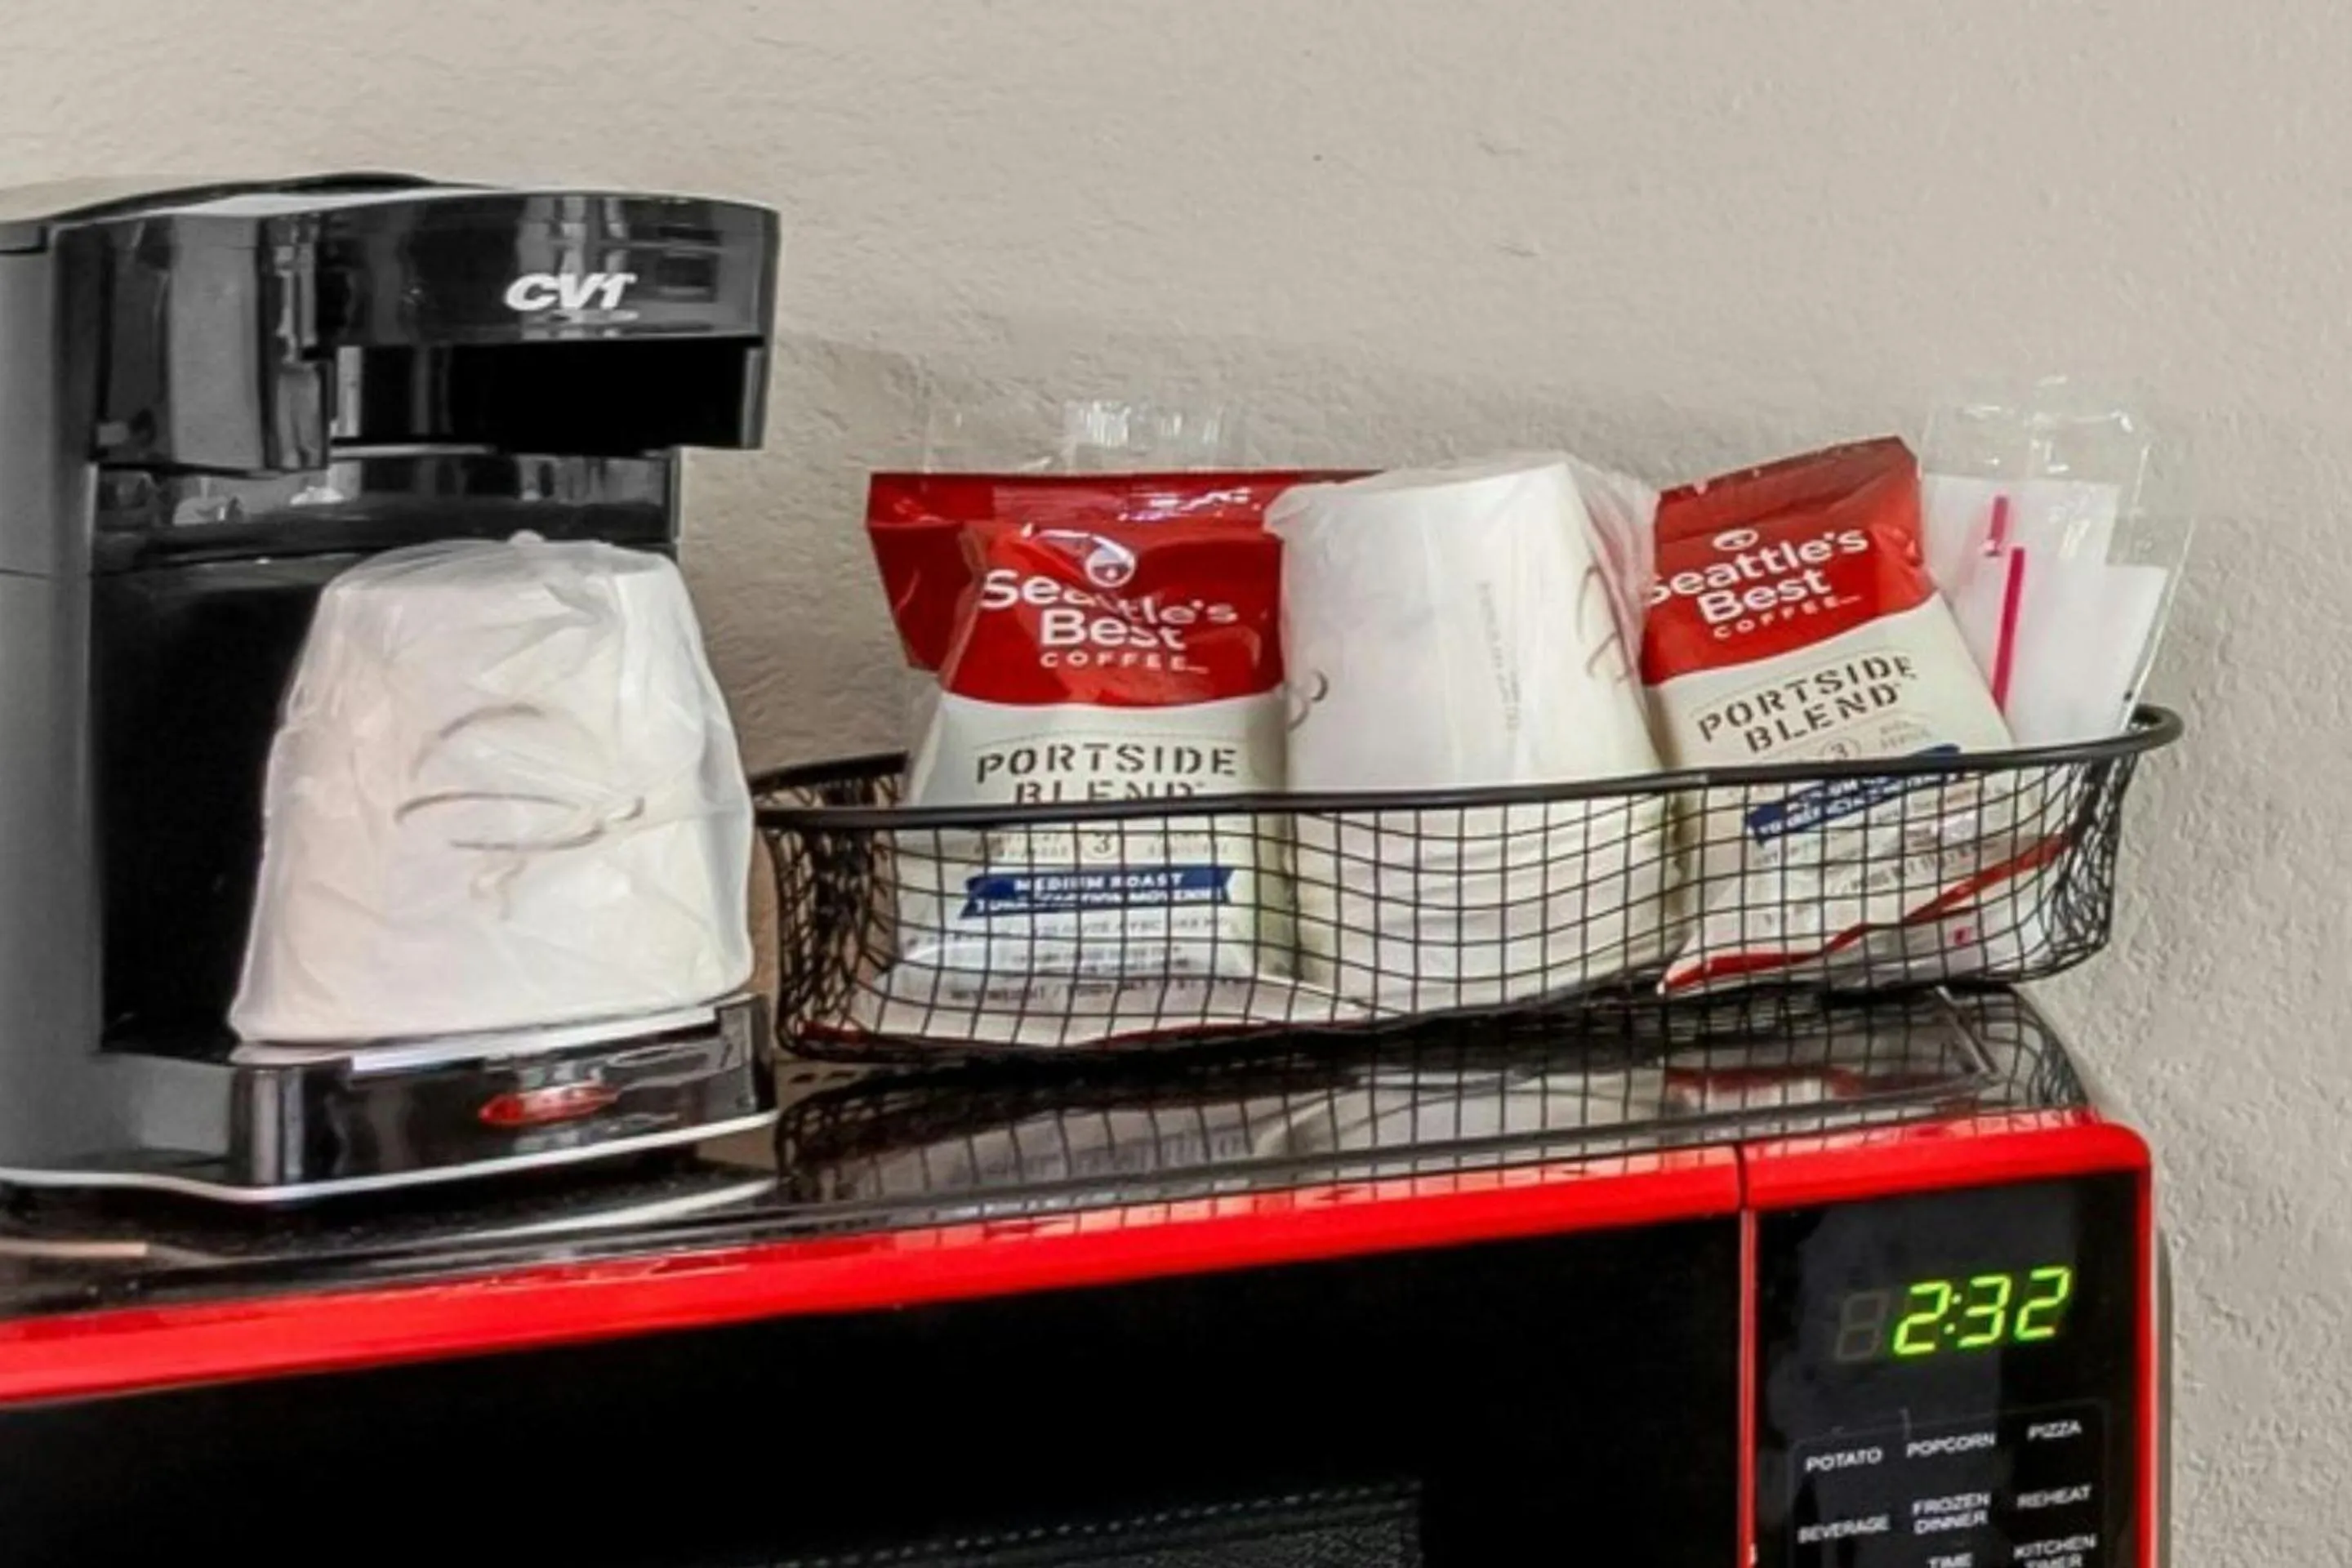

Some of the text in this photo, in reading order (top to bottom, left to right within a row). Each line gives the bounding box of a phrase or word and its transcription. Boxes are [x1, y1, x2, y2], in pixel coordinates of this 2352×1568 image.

[1697, 568, 1833, 624] Best
[1039, 608, 1187, 651] Best
[1712, 596, 1842, 640] COFFEE
[1039, 650, 1189, 671] COFFEE
[1697, 655, 1918, 742] PORTSIDE
[1743, 683, 1900, 753] BLEND
[976, 742, 1238, 784] PORTSIDE
[1893, 1267, 2071, 1355] 2:32
[2027, 1419, 2082, 1440] PIZZA
[1804, 1447, 1884, 1472] POTATO
[1906, 1432, 1996, 1459] POPCORN
[1911, 1492, 1992, 1516] FROZEN
[2016, 1484, 2093, 1509] REHEAT
[1797, 1514, 1891, 1544] BEVERAGE
[1913, 1510, 1989, 1535] DINNER
[2013, 1534, 2099, 1560] KITCHEN
